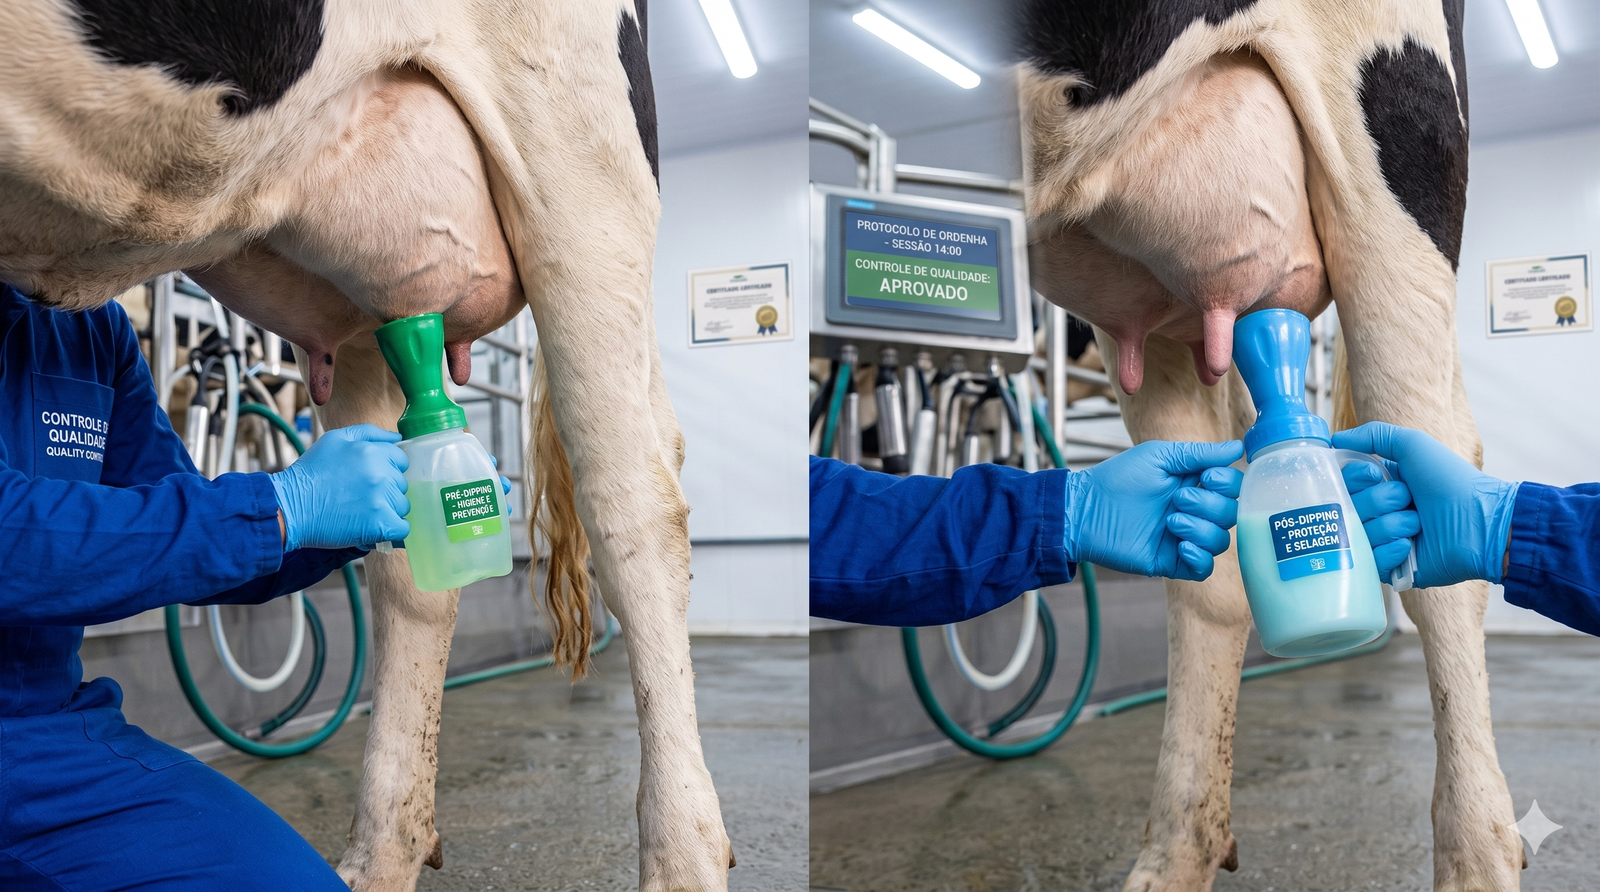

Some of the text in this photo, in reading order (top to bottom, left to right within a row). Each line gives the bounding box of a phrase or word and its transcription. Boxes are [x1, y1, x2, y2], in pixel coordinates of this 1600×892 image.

[857, 219, 988, 246] PROTOCOLO DE ORDENHA
[892, 238, 932, 253] SESSÃO
[935, 244, 962, 256] 14:00
[855, 258, 991, 284] CONTROLE DE QUALIDADE:
[879, 277, 968, 301] APROVADO
[41, 411, 102, 432] CONTROLE
[49, 428, 106, 450] QUALIDADE
[46, 446, 85, 459] QUALITY
[445, 484, 493, 501] PRÉ-DIPPING
[457, 496, 486, 509] HIGIENE
[486, 495, 491, 503] E
[1274, 510, 1339, 531] PÓS-DIPPING
[1288, 522, 1338, 540] PROTEÇÃO
[1285, 535, 1340, 553] E SELAGEM
